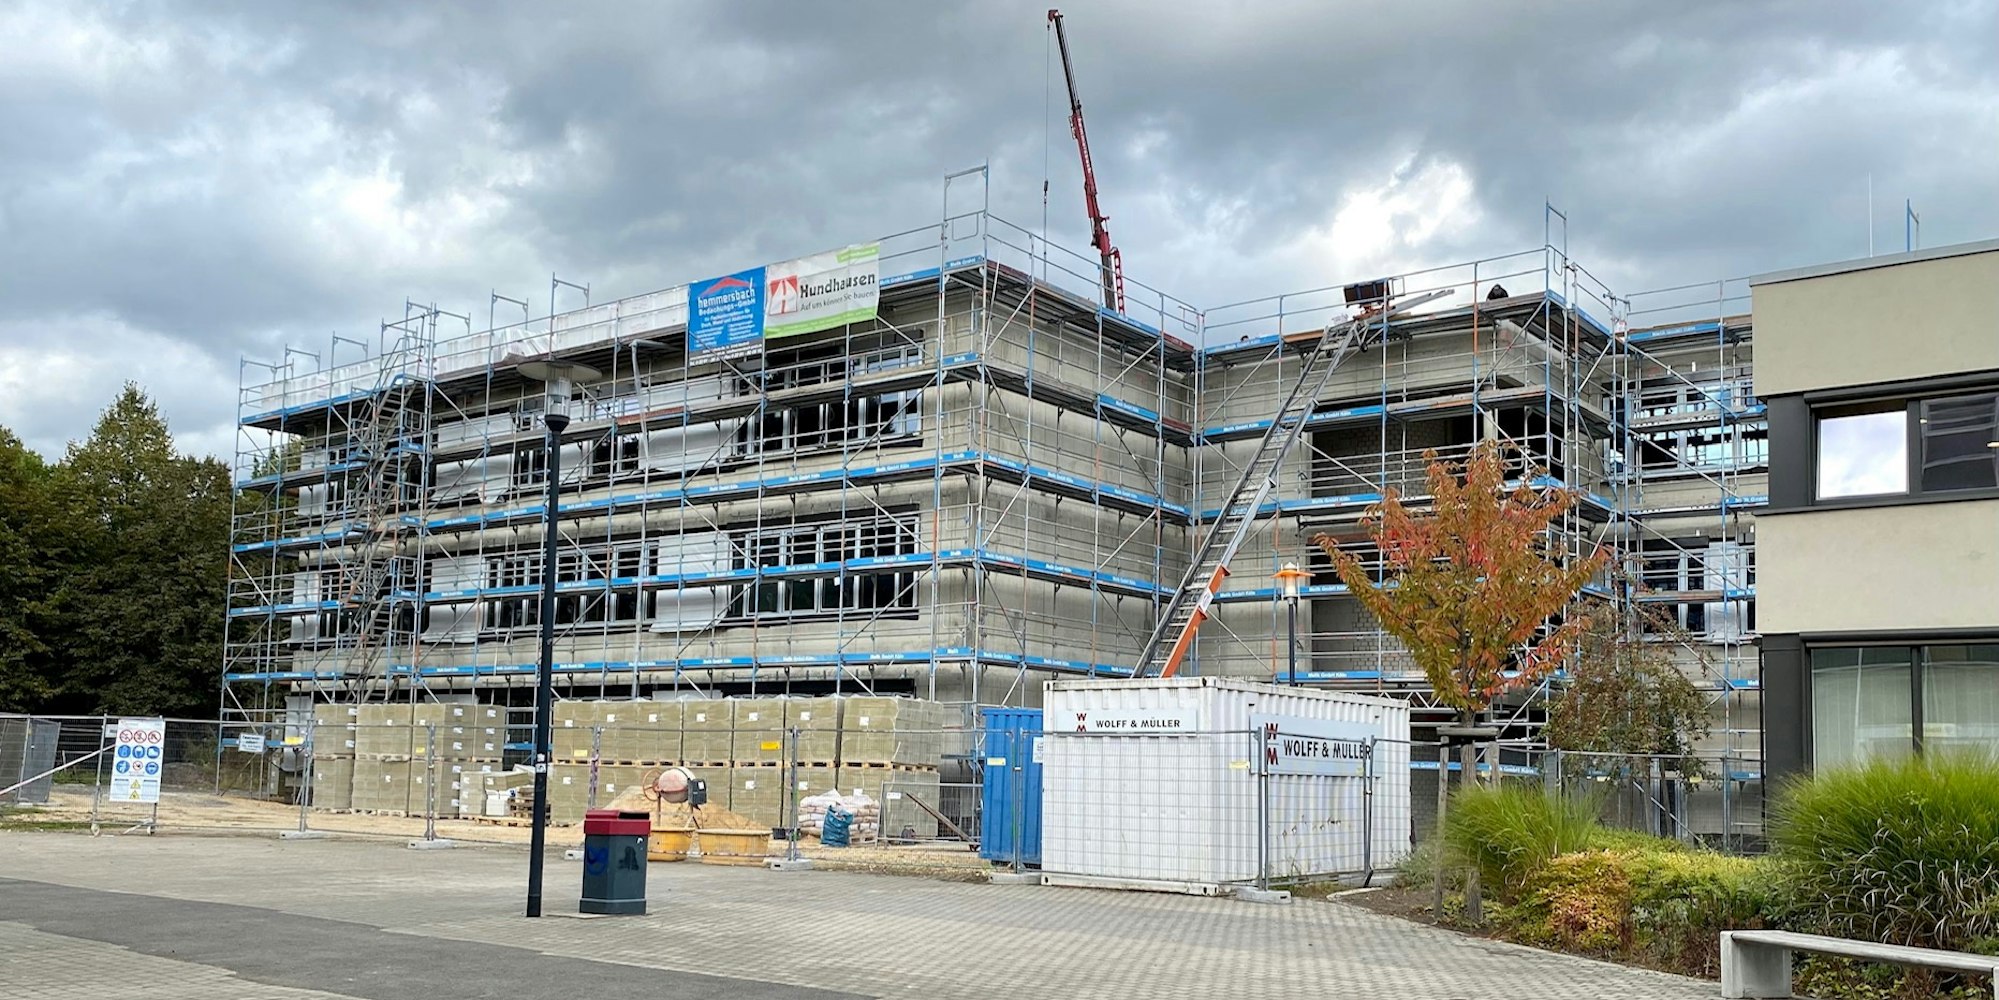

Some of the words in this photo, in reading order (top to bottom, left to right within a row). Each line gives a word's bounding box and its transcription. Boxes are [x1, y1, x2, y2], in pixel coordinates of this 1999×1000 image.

[698, 280, 756, 309] hemmersbach
[800, 274, 874, 298] Hundhausen
[1096, 720, 1127, 728] WOLFF
[1141, 717, 1180, 728] MÜLLER
[1284, 740, 1319, 757] WOLFF
[1322, 742, 1329, 758] &
